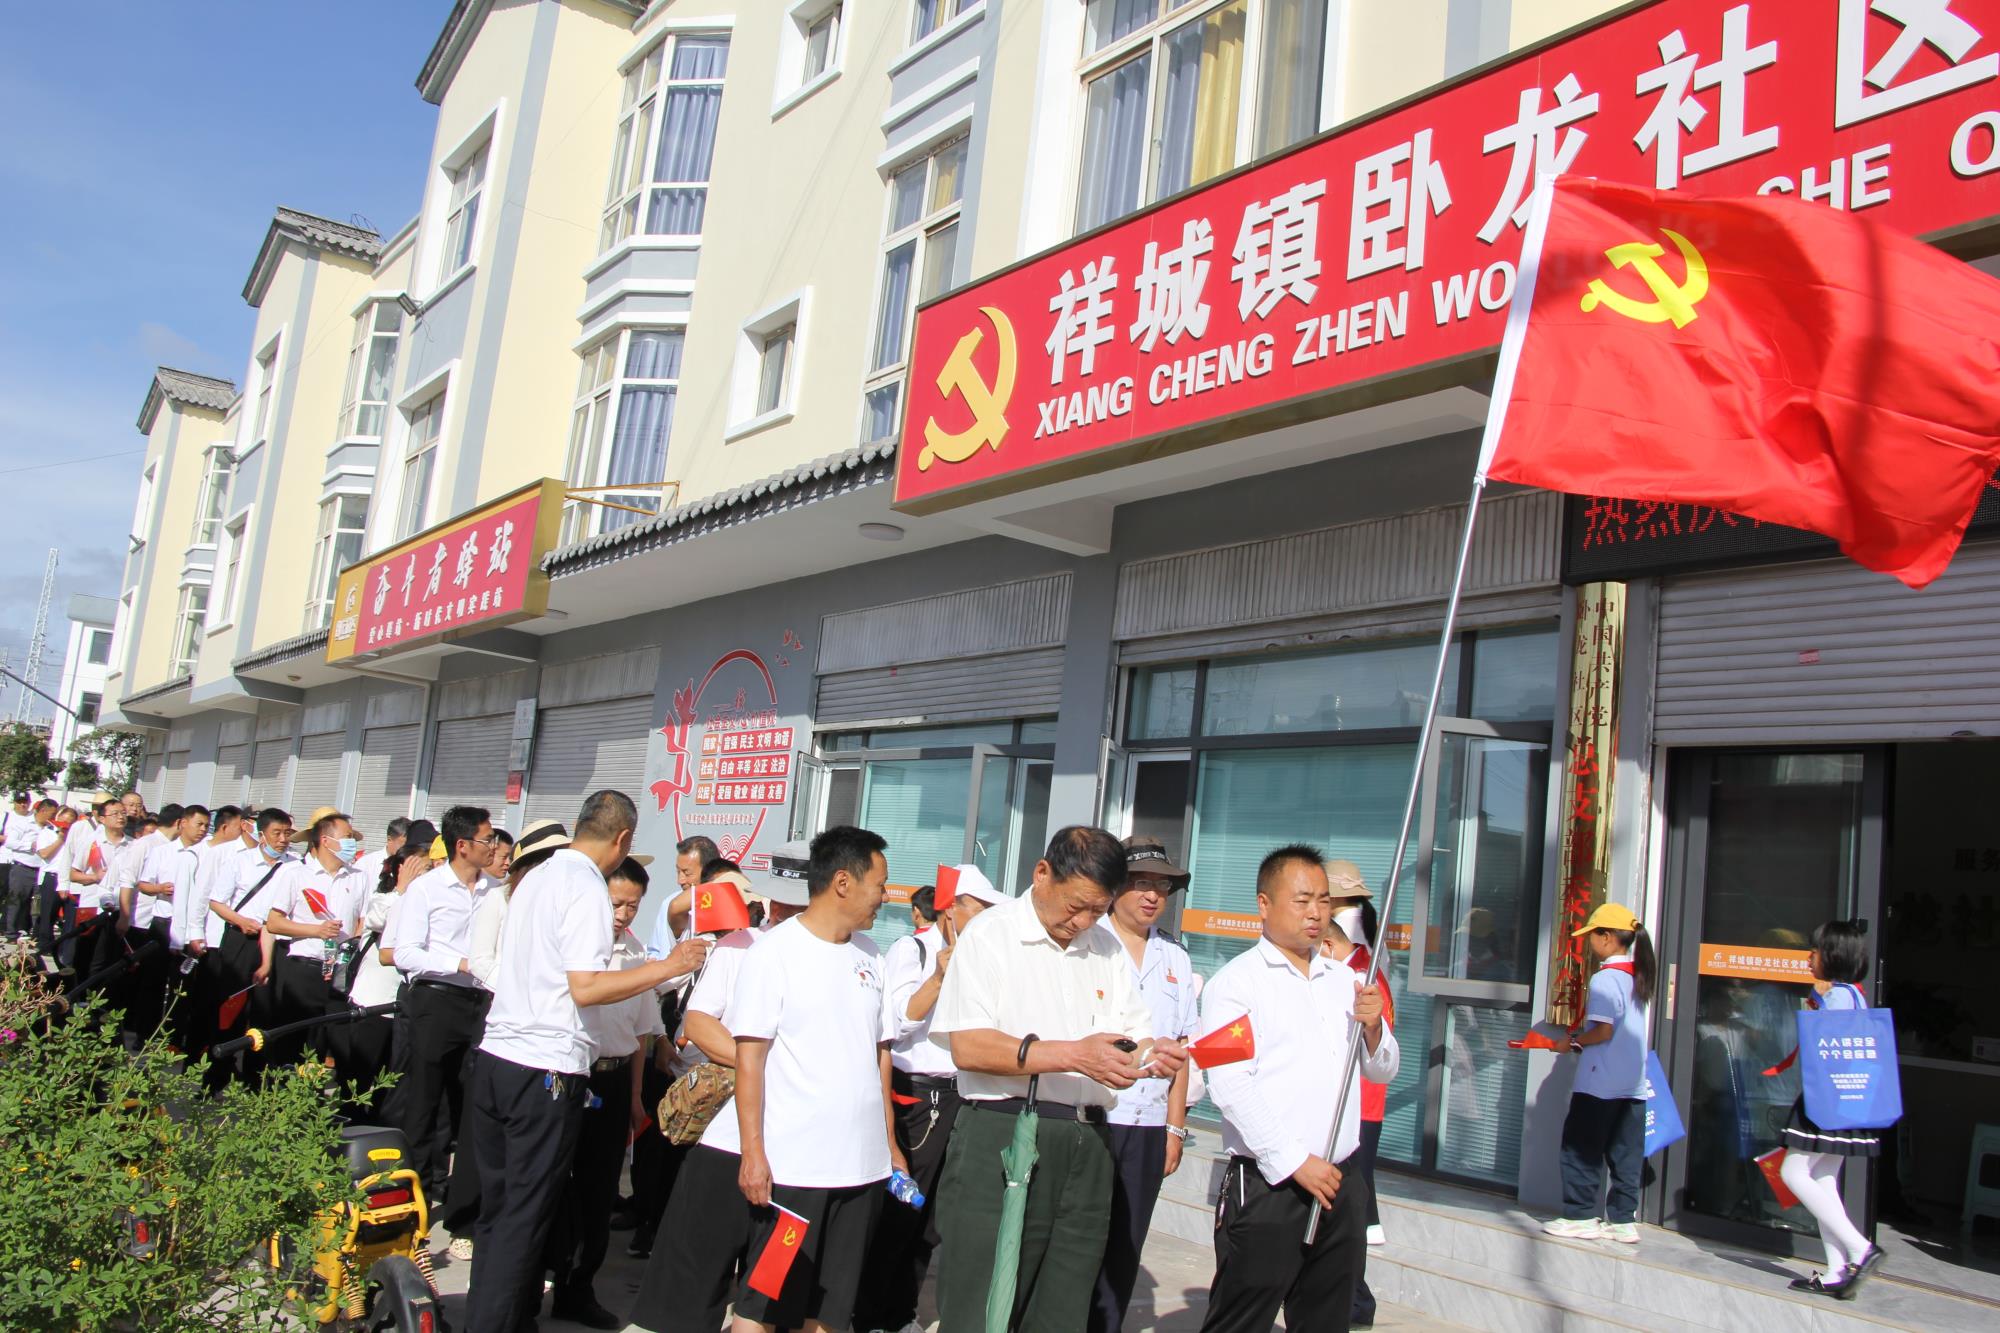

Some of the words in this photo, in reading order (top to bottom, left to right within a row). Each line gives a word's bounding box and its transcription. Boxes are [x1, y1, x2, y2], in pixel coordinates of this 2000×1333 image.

[1045, 0, 2000, 385] 祥城镇卧龙社区
[1034, 376, 1133, 438] XIANG
[1149, 333, 1275, 406] CHENG
[1292, 291, 1408, 366] ZHEN
[1432, 260, 1517, 326] WO
[1588, 598, 1615, 728] 中国共产党
[701, 761, 714, 775] 社会
[720, 761, 735, 775] 自由
[737, 760, 752, 774] 平等
[753, 759, 769, 773] 公正
[770, 757, 786, 773] 法治
[723, 735, 738, 751] 富强
[740, 734, 754, 749] 民主
[756, 732, 772, 748] 文明
[774, 730, 790, 747] 和谐
[697, 786, 710, 799] 公民
[718, 785, 732, 800] 爱国
[734, 784, 748, 800] 敬业
[751, 784, 766, 799] 诚信
[768, 784, 784, 799] 友善
